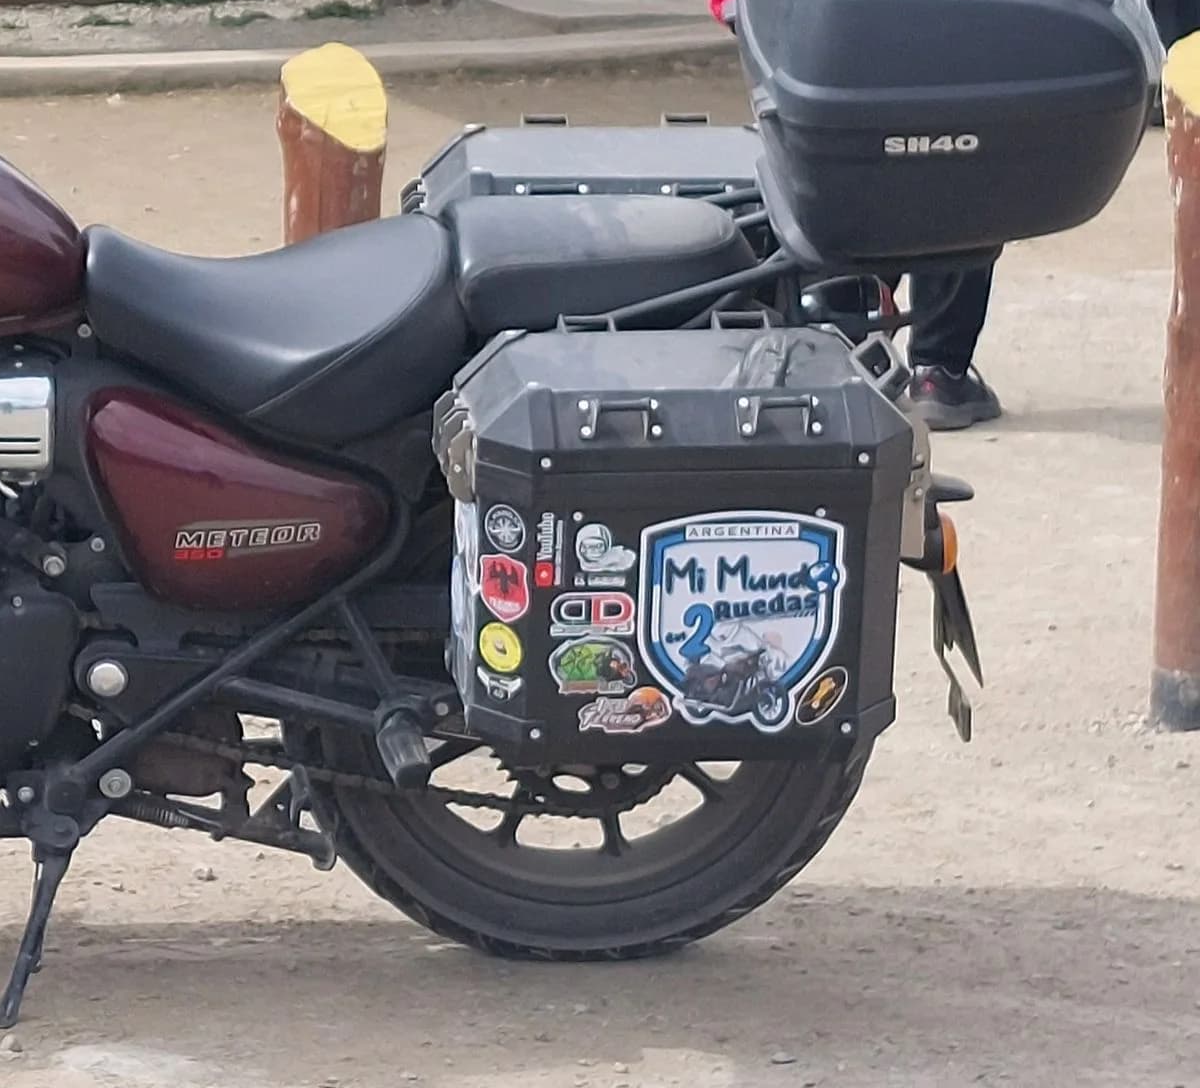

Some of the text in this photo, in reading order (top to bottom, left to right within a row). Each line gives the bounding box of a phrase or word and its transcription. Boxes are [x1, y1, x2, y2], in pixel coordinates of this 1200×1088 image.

[884, 134, 979, 153] SH40
[175, 522, 321, 548] METEOR
[688, 524, 797, 538] ARGENTINA
[175, 549, 225, 560] 350
[664, 555, 707, 596] Mi
[678, 602, 715, 661] 2
[714, 592, 819, 620] Ruedas
